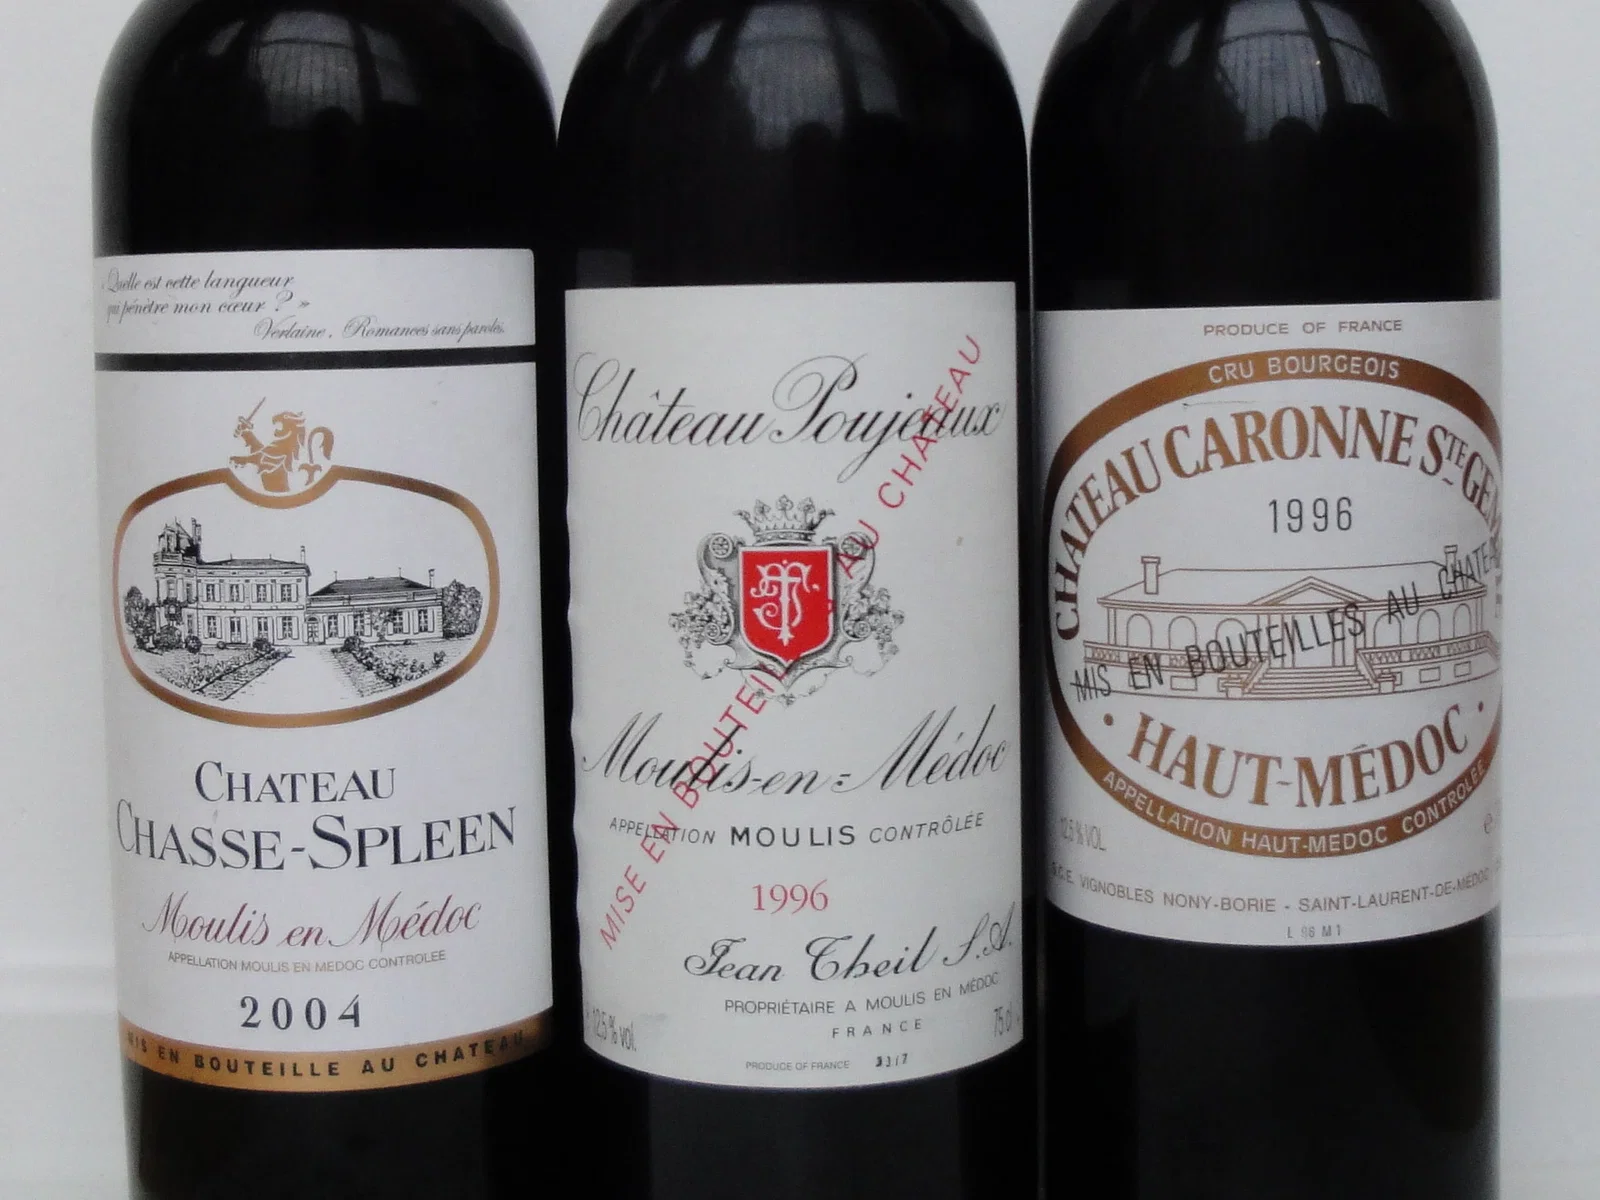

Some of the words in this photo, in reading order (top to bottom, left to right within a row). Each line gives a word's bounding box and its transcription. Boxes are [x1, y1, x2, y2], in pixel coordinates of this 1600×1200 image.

[144, 275, 162, 290] est
[166, 275, 200, 289] cette
[204, 269, 294, 297] langueur
[174, 302, 212, 314] mon
[342, 315, 429, 339] Romances
[431, 323, 461, 337] sans
[1203, 322, 1289, 337] PRODUCE
[1302, 321, 1326, 335] OF
[1338, 319, 1402, 334] FRANCE
[1208, 361, 1255, 384] CRU
[1267, 354, 1400, 380] BOURGEOIS
[573, 351, 773, 447] Château
[768, 353, 1007, 484] Poujeaux
[1055, 438, 1162, 641] CHATEAU
[1163, 404, 1419, 479] CARONNE
[1268, 496, 1353, 534] 1996
[599, 864, 648, 950] MISE
[639, 810, 680, 864] EN
[836, 518, 880, 579] AU
[877, 333, 982, 510] CHATEAU
[1073, 663, 1111, 703] MIS
[1128, 653, 1164, 690] EN
[1185, 601, 1365, 680] BOUTEILLES
[1385, 581, 1421, 625] AU
[1127, 702, 1469, 809] HAUT-MÉDOC
[194, 760, 396, 804] CHATEAU
[608, 816, 716, 846] APPELLATION
[730, 824, 856, 847] MOULIS
[868, 809, 985, 844] CONTRÔLÉE
[1101, 769, 1232, 847] APPELLATION
[1240, 826, 1389, 855] HAUT-MEDOC
[116, 798, 517, 871] CHASSE-SPLEEN
[751, 879, 830, 915] 1996
[1079, 872, 1155, 904] VIGNOBLES
[1163, 891, 1277, 913] NONY-BORIE
[141, 890, 270, 946] Moulis
[275, 922, 330, 948] en
[328, 890, 483, 952] Médoc
[167, 950, 238, 972] APPELLATION
[240, 959, 290, 973] MOULIS
[292, 961, 311, 973] EN
[314, 958, 365, 972] MEDOC
[368, 949, 447, 970] CONTROLEE
[683, 937, 784, 982] Jean
[804, 925, 940, 982] Theil
[239, 994, 361, 1031] 2004
[723, 997, 836, 1016] PROPRIÉTAIRE
[865, 991, 926, 1012] MOULIS
[933, 985, 953, 1002] EN
[958, 970, 999, 996] MÉDOC
[831, 1017, 922, 1040] FRANCE
[157, 1044, 180, 1064] EN
[193, 1052, 341, 1078] BOUTEILLE
[361, 1055, 395, 1074] AU
[414, 1029, 523, 1070] CHATEAU
[745, 1060, 794, 1071] PRODUCE
[795, 1060, 809, 1071] OF
[810, 1059, 851, 1071] FRANCE
